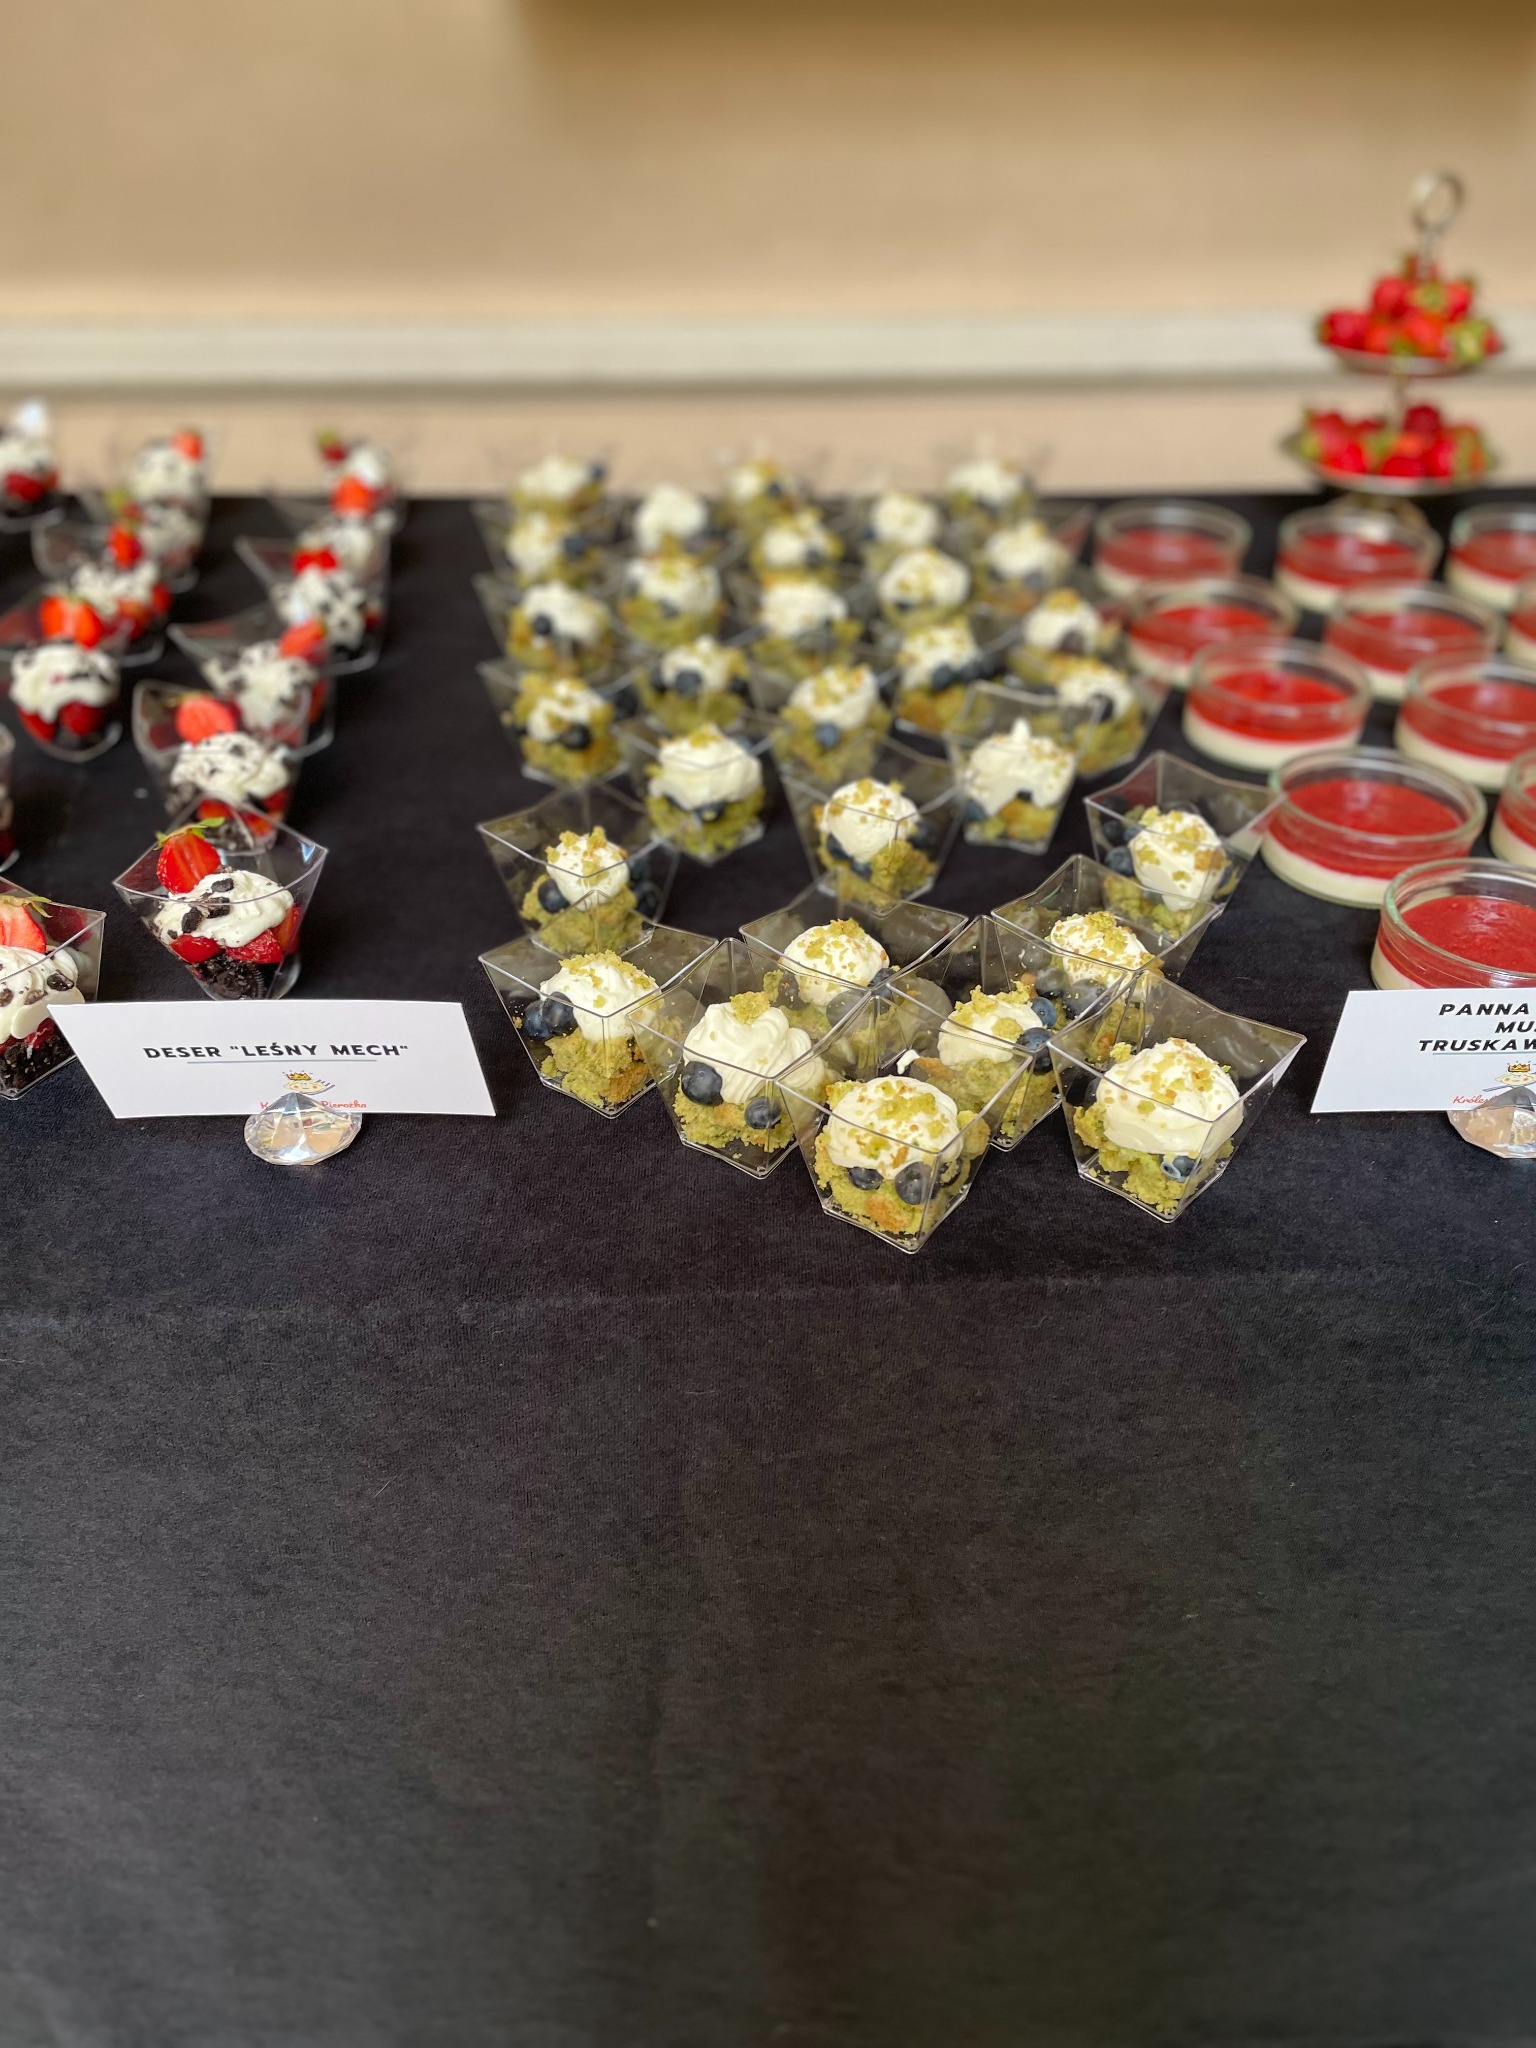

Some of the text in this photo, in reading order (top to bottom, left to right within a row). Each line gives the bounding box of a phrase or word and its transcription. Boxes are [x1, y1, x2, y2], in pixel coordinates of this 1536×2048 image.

[1438, 1003, 1529, 1016] PANNA
[1494, 1021, 1536, 1034] MU
[143, 1042, 409, 1059] DESER "LEŚNY MECH"
